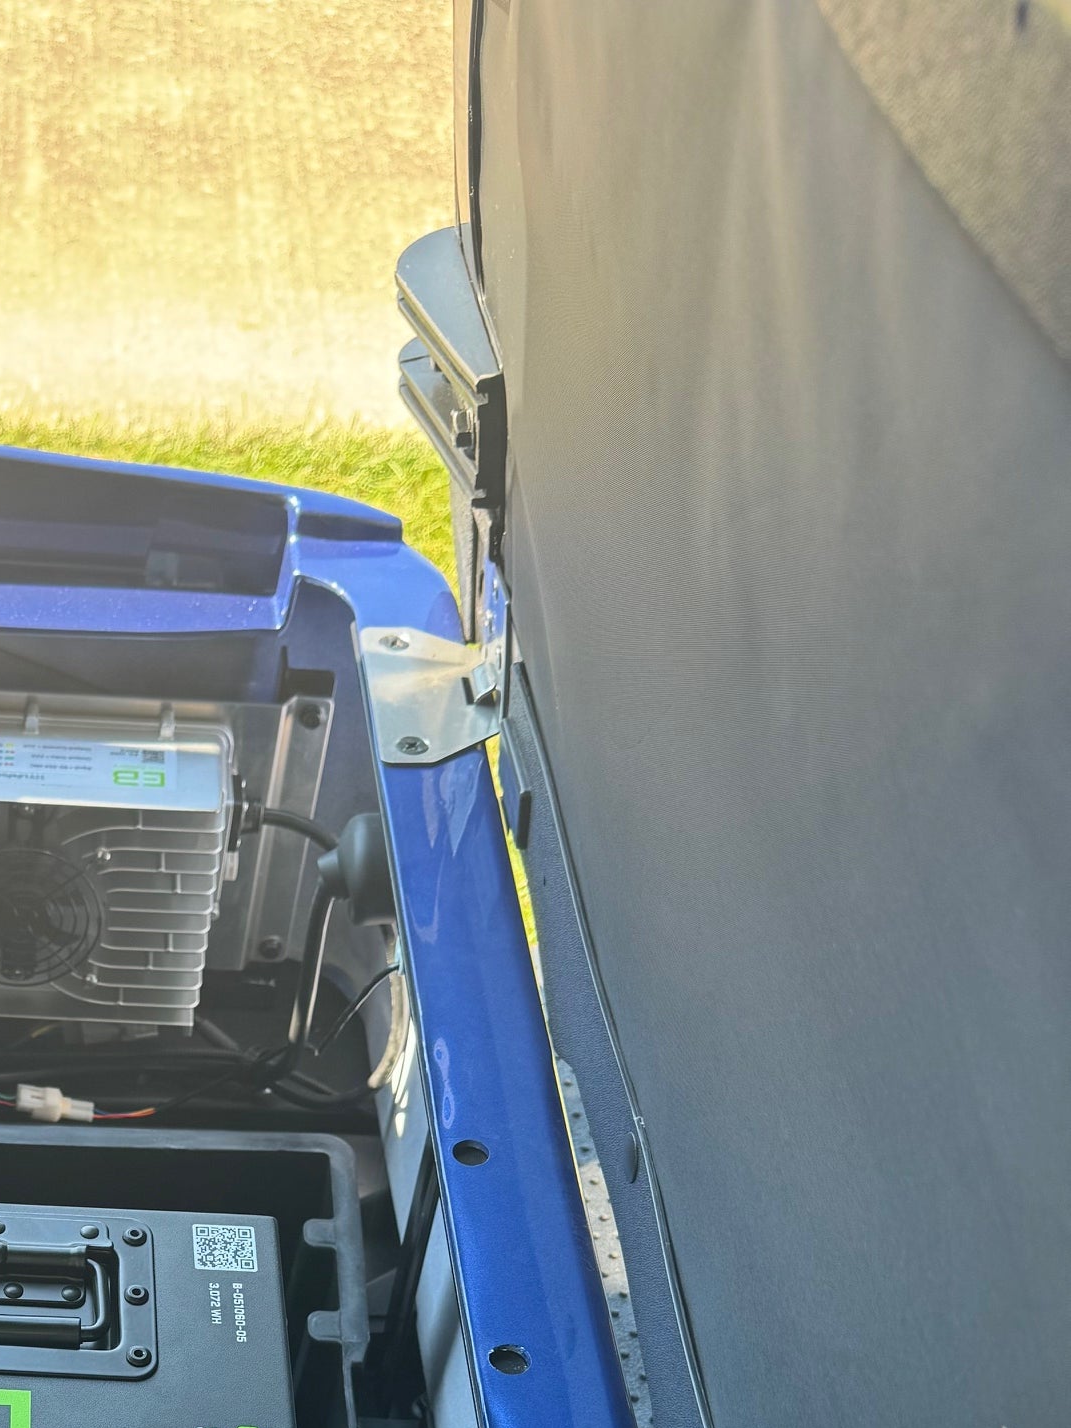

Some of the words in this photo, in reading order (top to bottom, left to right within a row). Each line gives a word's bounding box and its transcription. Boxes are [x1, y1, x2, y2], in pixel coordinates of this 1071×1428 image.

[113, 770, 165, 788] EB
[209, 1283, 220, 1307] 3,072
[211, 1309, 222, 1324] WH
[233, 1283, 246, 1342] B-051060-05
